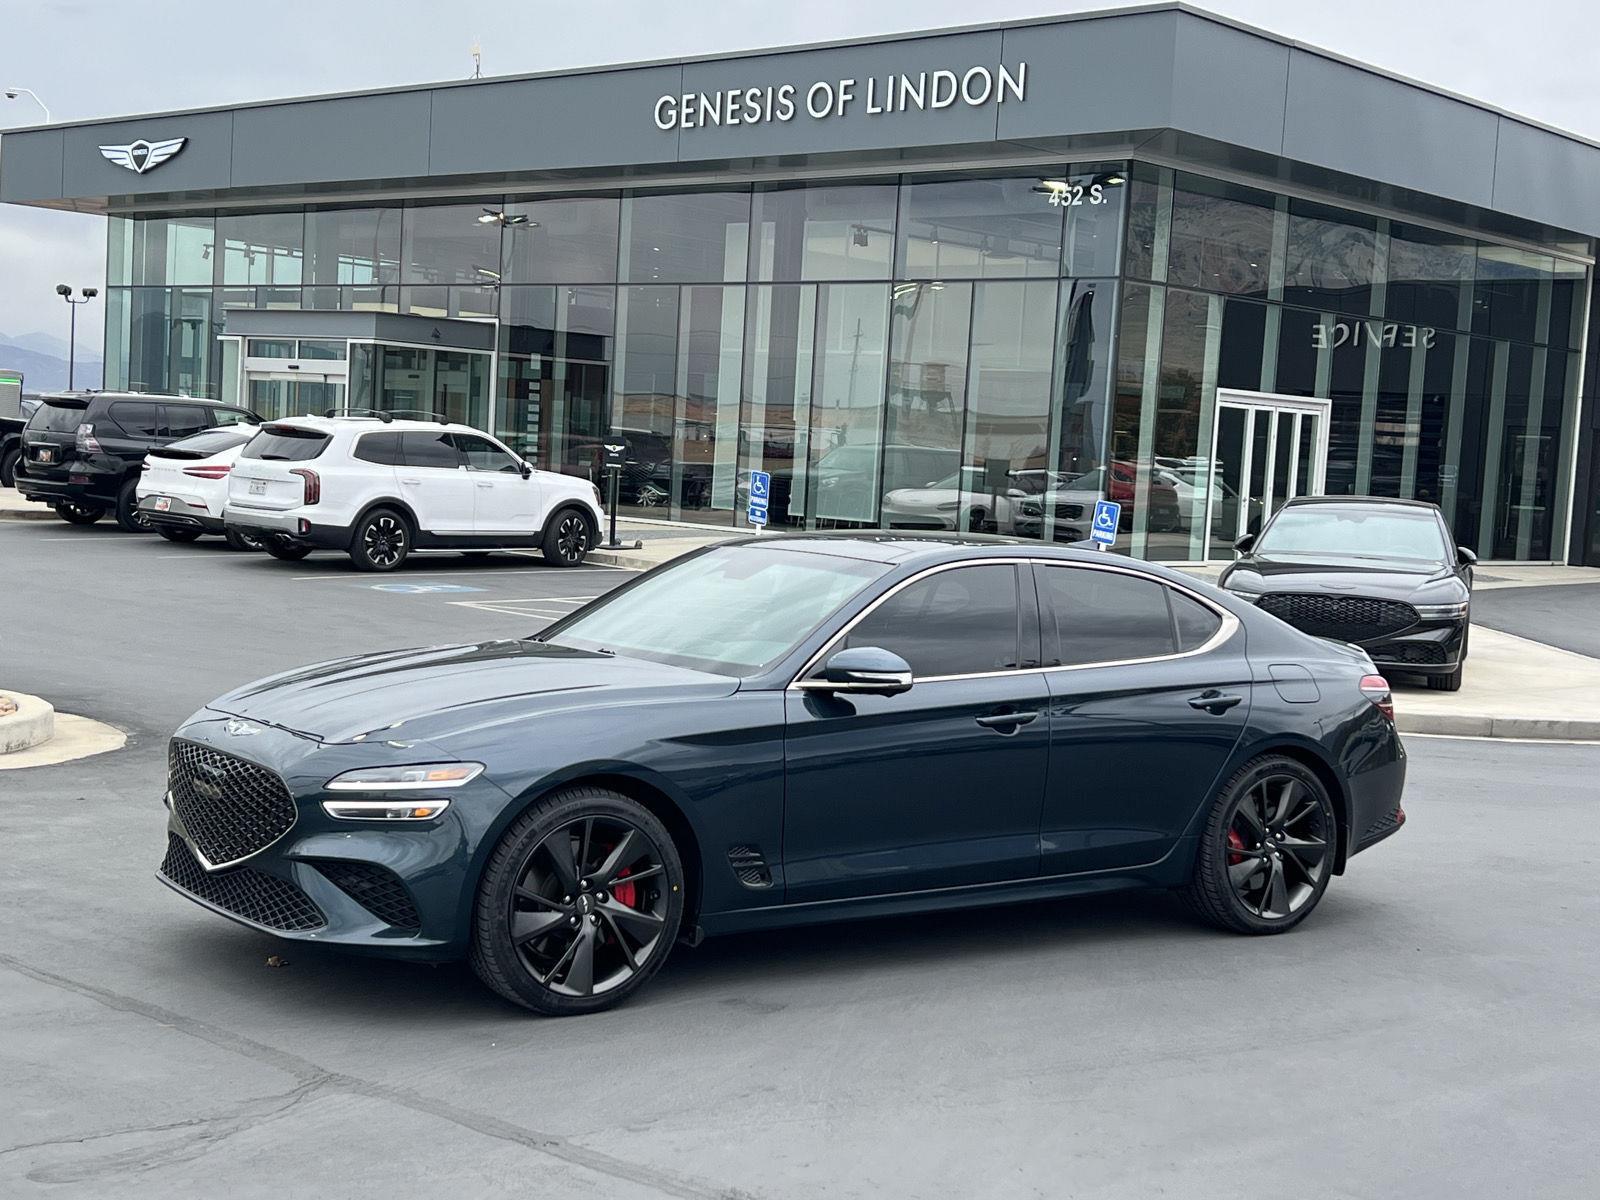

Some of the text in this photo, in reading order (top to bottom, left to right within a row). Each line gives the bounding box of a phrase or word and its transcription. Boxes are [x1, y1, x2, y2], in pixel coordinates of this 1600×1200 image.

[654, 62, 1026, 130] GENESIS OF LINDON
[1048, 184, 1108, 207] 452 S.
